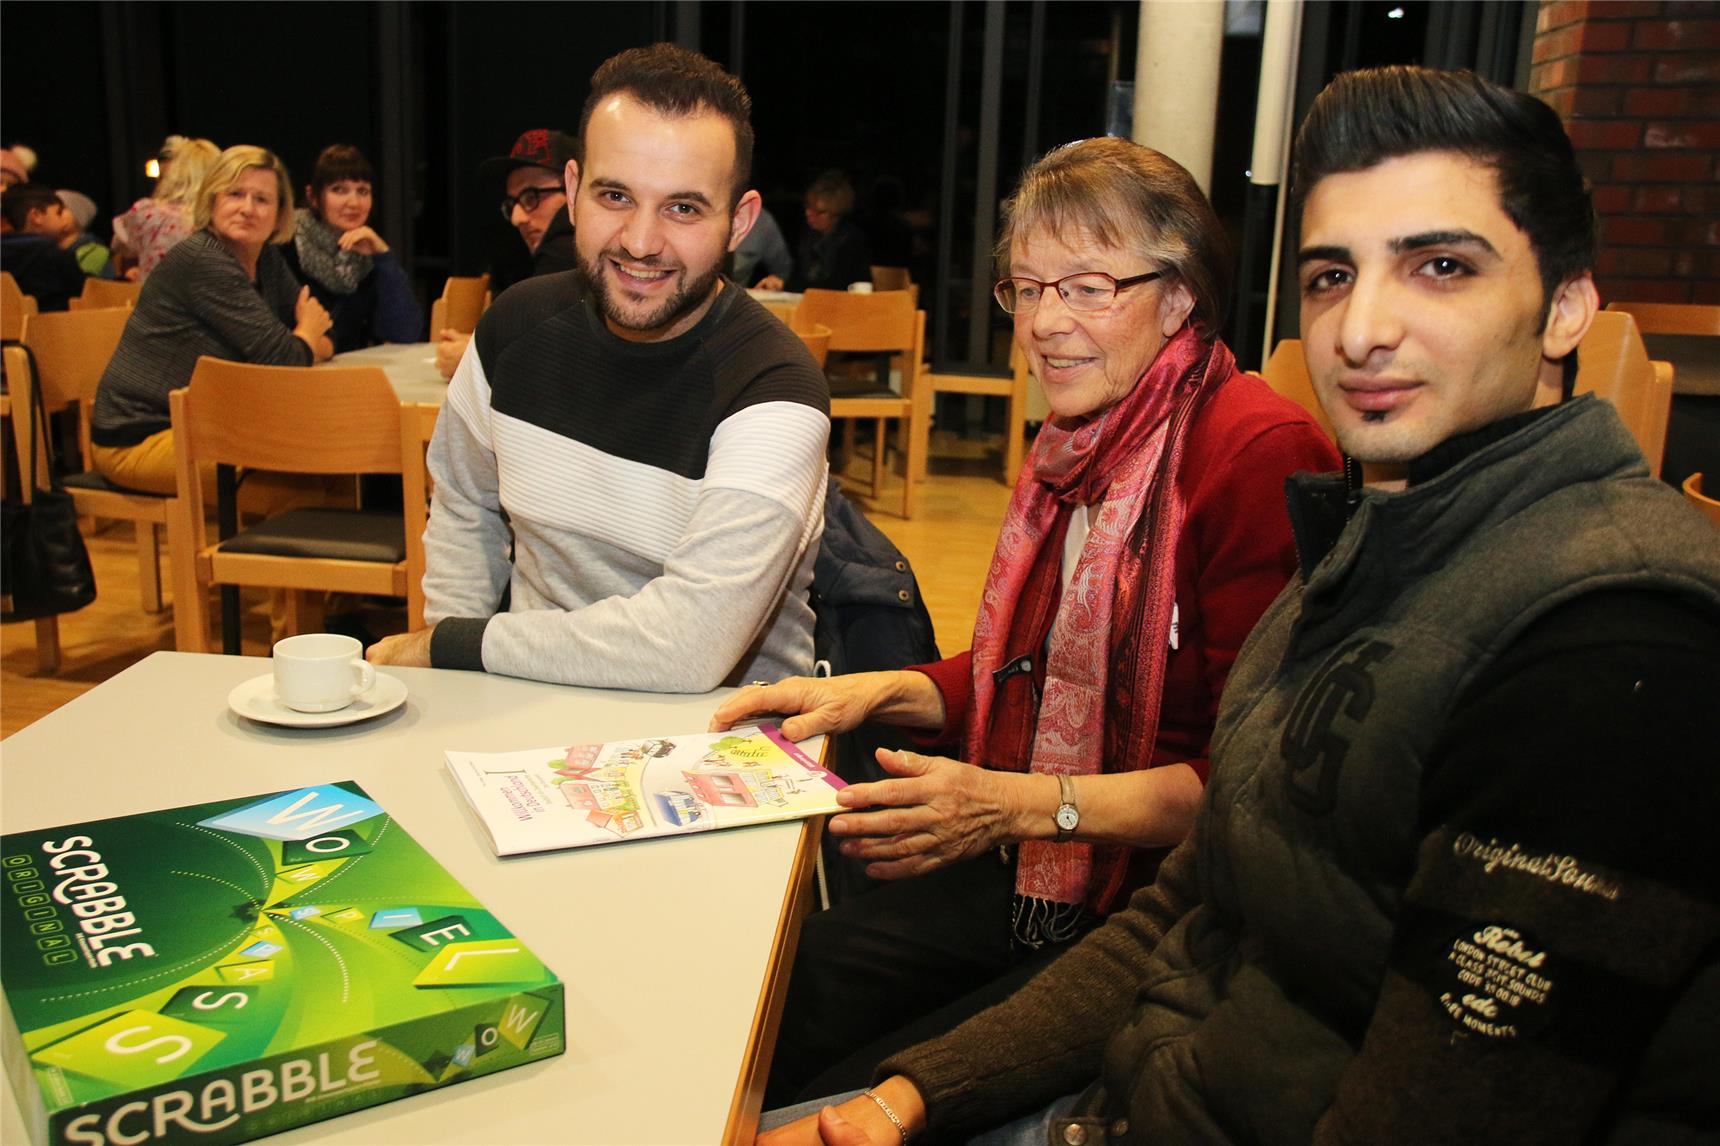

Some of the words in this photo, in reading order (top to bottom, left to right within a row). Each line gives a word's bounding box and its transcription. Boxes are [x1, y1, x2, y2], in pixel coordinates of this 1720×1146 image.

[6, 855, 76, 964] ORIGINAL
[42, 835, 156, 968] SCRABBLE
[1453, 938, 1486, 961] LONDON
[1455, 954, 1486, 974] CLASS
[64, 1039, 381, 1146] SCRABBLE
